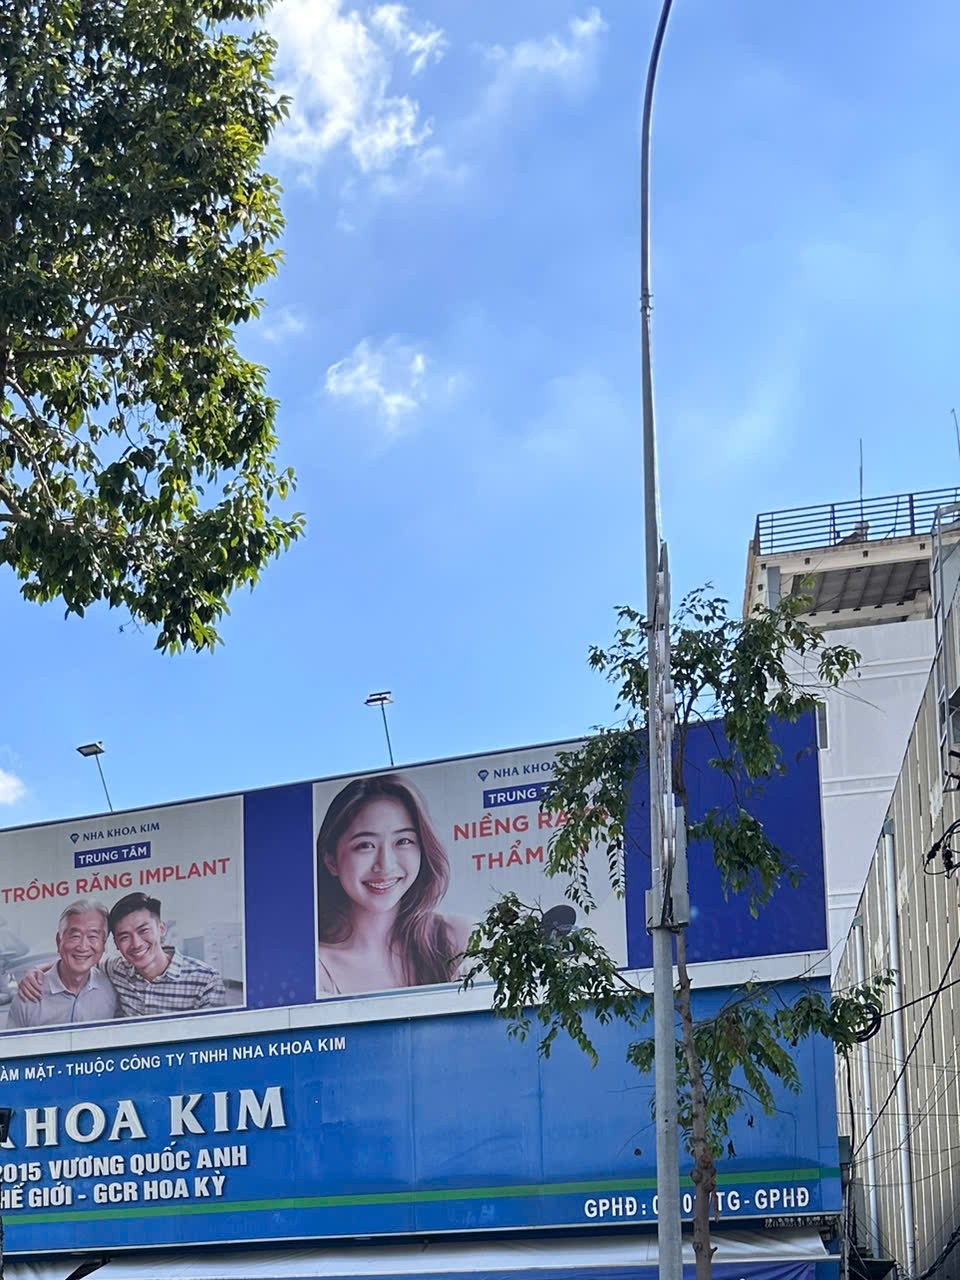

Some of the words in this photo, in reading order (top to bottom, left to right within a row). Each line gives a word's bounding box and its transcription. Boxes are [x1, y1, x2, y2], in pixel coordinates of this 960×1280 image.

[494, 766, 519, 779] NHA
[488, 788, 537, 804] TRUNG
[83, 831, 104, 842] NHA
[107, 826, 137, 838] KHOA
[140, 822, 160, 833] KIM
[454, 812, 529, 841] NIỀNG
[79, 851, 118, 865] TRUNG
[121, 845, 147, 860] TÂM
[472, 841, 544, 871] THẨM
[1, 878, 69, 903] TRỒNG
[76, 872, 133, 894] RĂNG
[139, 858, 230, 886] IMPLANT
[25, 1063, 55, 1082] MẶT
[66, 1057, 115, 1077] THUỘC
[120, 1054, 161, 1071] CÔNG
[166, 1053, 185, 1067] TY
[190, 1049, 228, 1065] TNHH
[232, 1045, 263, 1061] NHA
[269, 1040, 313, 1056] KHOA
[318, 1036, 346, 1051] KIM
[0, 1099, 147, 1149] HOA
[168, 1086, 287, 1137] KIM
[49, 1154, 125, 1181] VƯƠNG
[130, 1141, 190, 1175] QUỐC
[196, 1145, 247, 1169] ANH
[0, 1182, 24, 1210] HẾ
[29, 1181, 72, 1208] GIỚI
[94, 1181, 138, 1204] GCR
[143, 1178, 189, 1201] HOA
[194, 1170, 226, 1197] KỲ
[755, 1186, 809, 1209] GPHĐ
